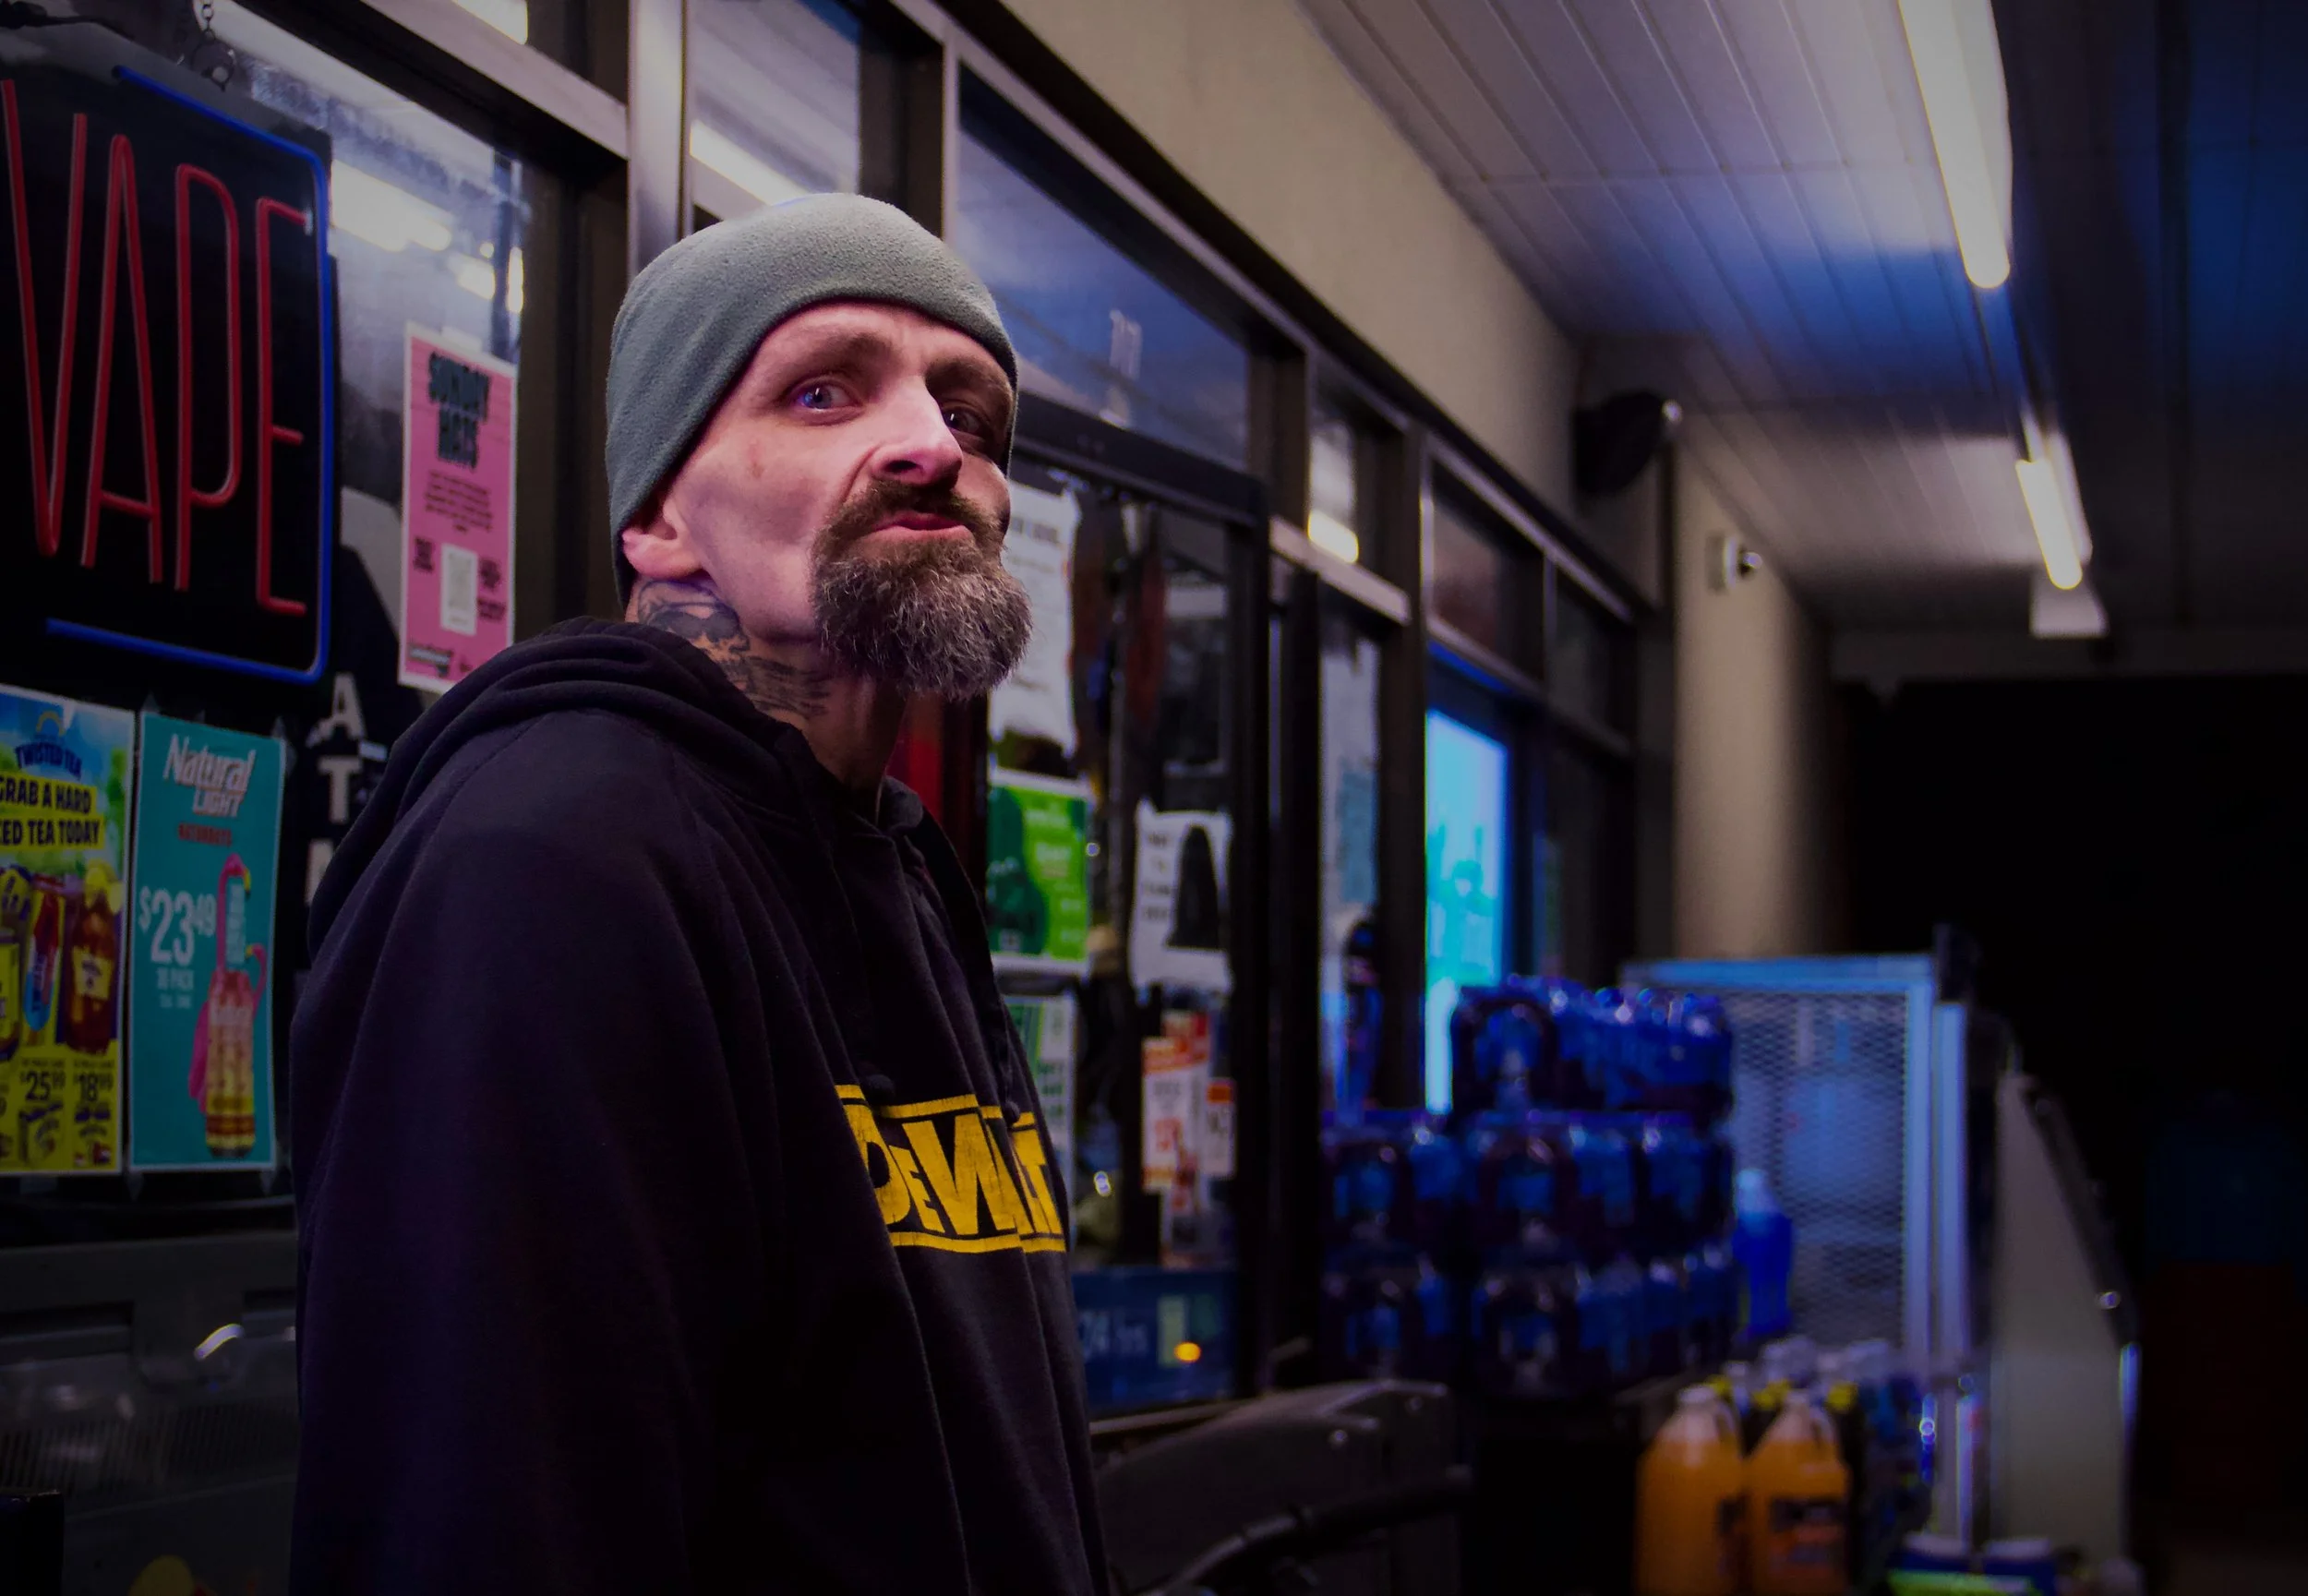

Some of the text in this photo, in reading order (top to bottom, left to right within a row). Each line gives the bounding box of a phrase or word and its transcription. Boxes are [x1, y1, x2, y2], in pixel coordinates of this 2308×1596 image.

[2, 78, 308, 617] VAPE
[16, 741, 82, 780] TWISTED TEA
[162, 733, 257, 793] Natural
[42, 782, 52, 807] A
[55, 785, 91, 814] HARD
[192, 786, 245, 818] LIGHT
[0, 819, 101, 846] ED TEA TODAY
